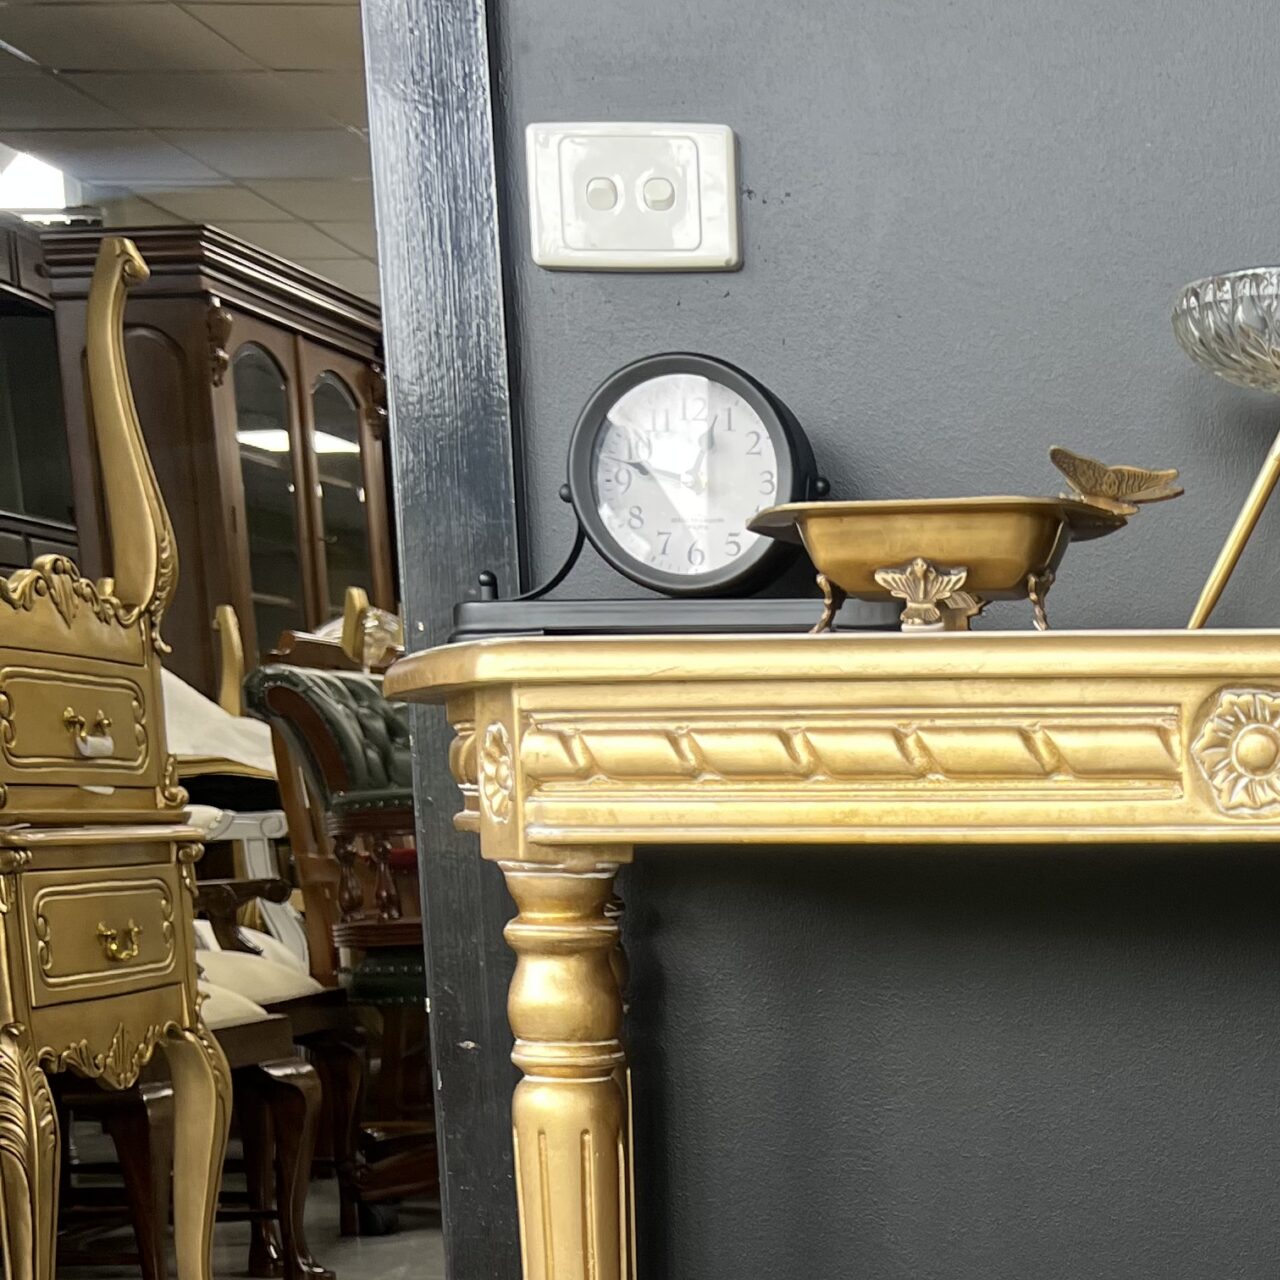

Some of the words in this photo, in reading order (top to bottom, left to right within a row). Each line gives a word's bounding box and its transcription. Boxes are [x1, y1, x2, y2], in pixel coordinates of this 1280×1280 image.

[647, 408, 670, 432] 11
[679, 396, 707, 422] 12
[724, 408, 736, 432] 1
[626, 438, 653, 462] 10
[745, 431, 762, 456] 2
[614, 468, 632, 494] 9
[759, 471, 775, 495] 3
[628, 505, 645, 530] 8
[657, 531, 673, 555] 7
[687, 540, 705, 566] 6
[724, 532, 742, 556] 5
